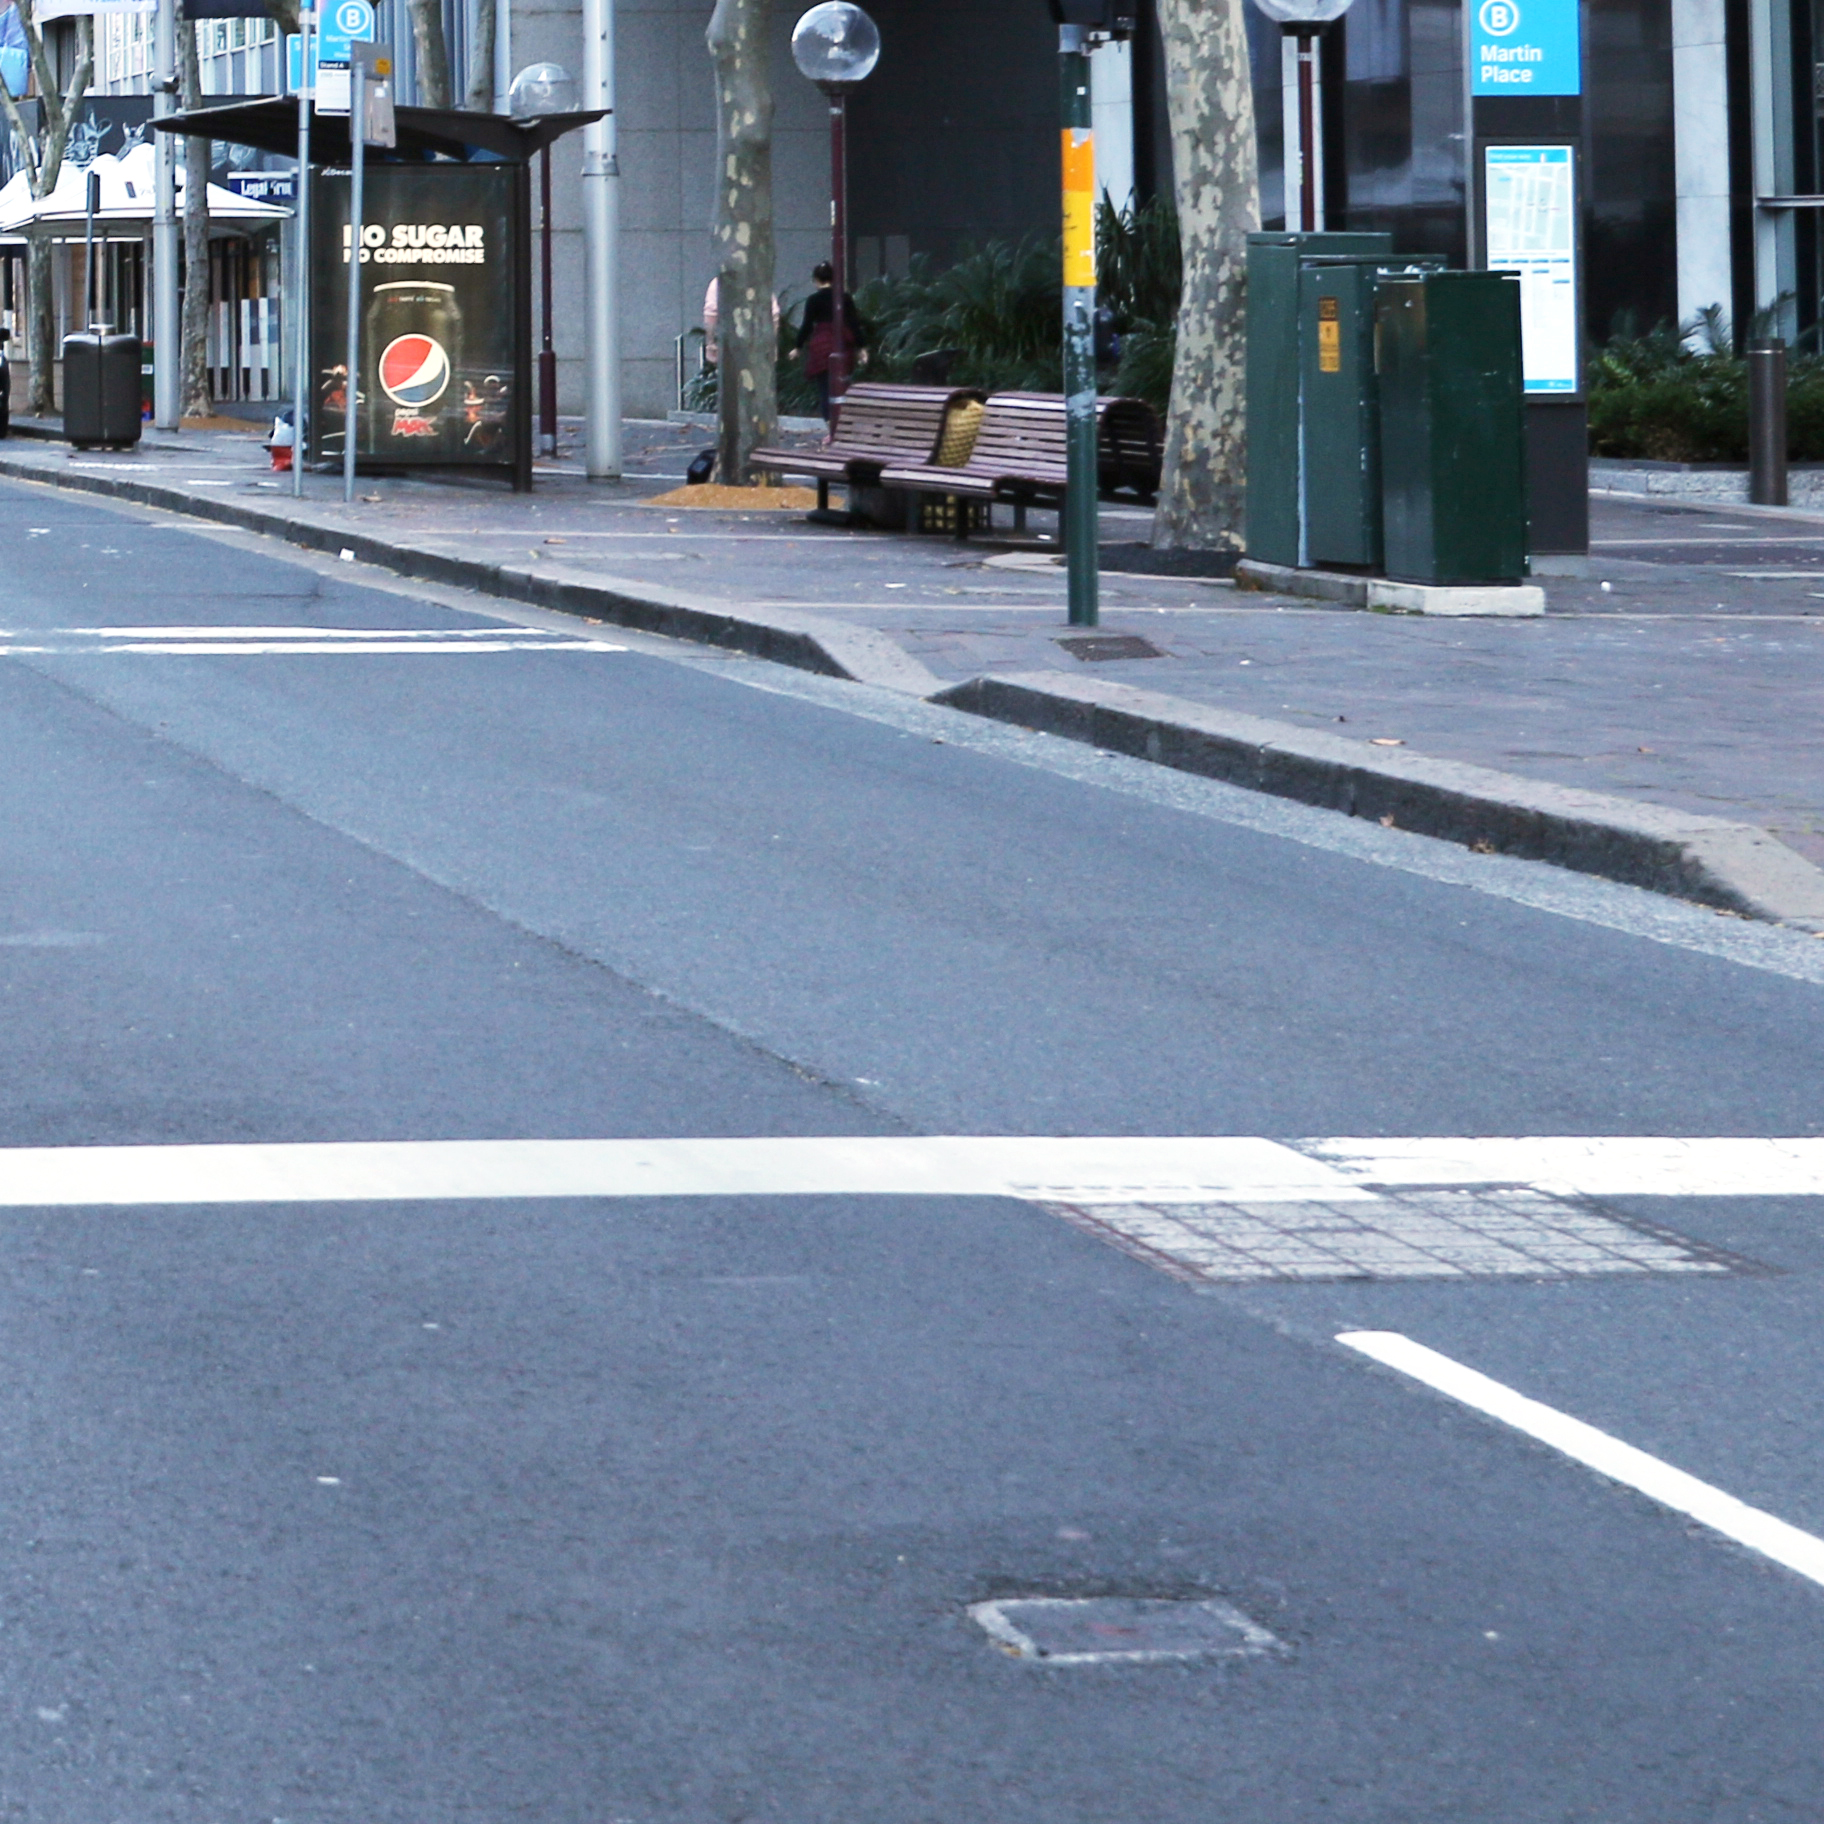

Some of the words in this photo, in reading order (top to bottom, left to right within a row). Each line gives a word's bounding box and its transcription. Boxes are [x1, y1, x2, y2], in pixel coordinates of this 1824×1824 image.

[346, 8, 361, 28] B
[1491, 5, 1508, 28] B
[1480, 44, 1543, 62] Martin
[1481, 65, 1533, 83] Place
[241, 179, 267, 198] Legal
[342, 224, 386, 248] NO
[392, 224, 484, 248] SUGAR
[373, 248, 485, 264] COMPROMISE
